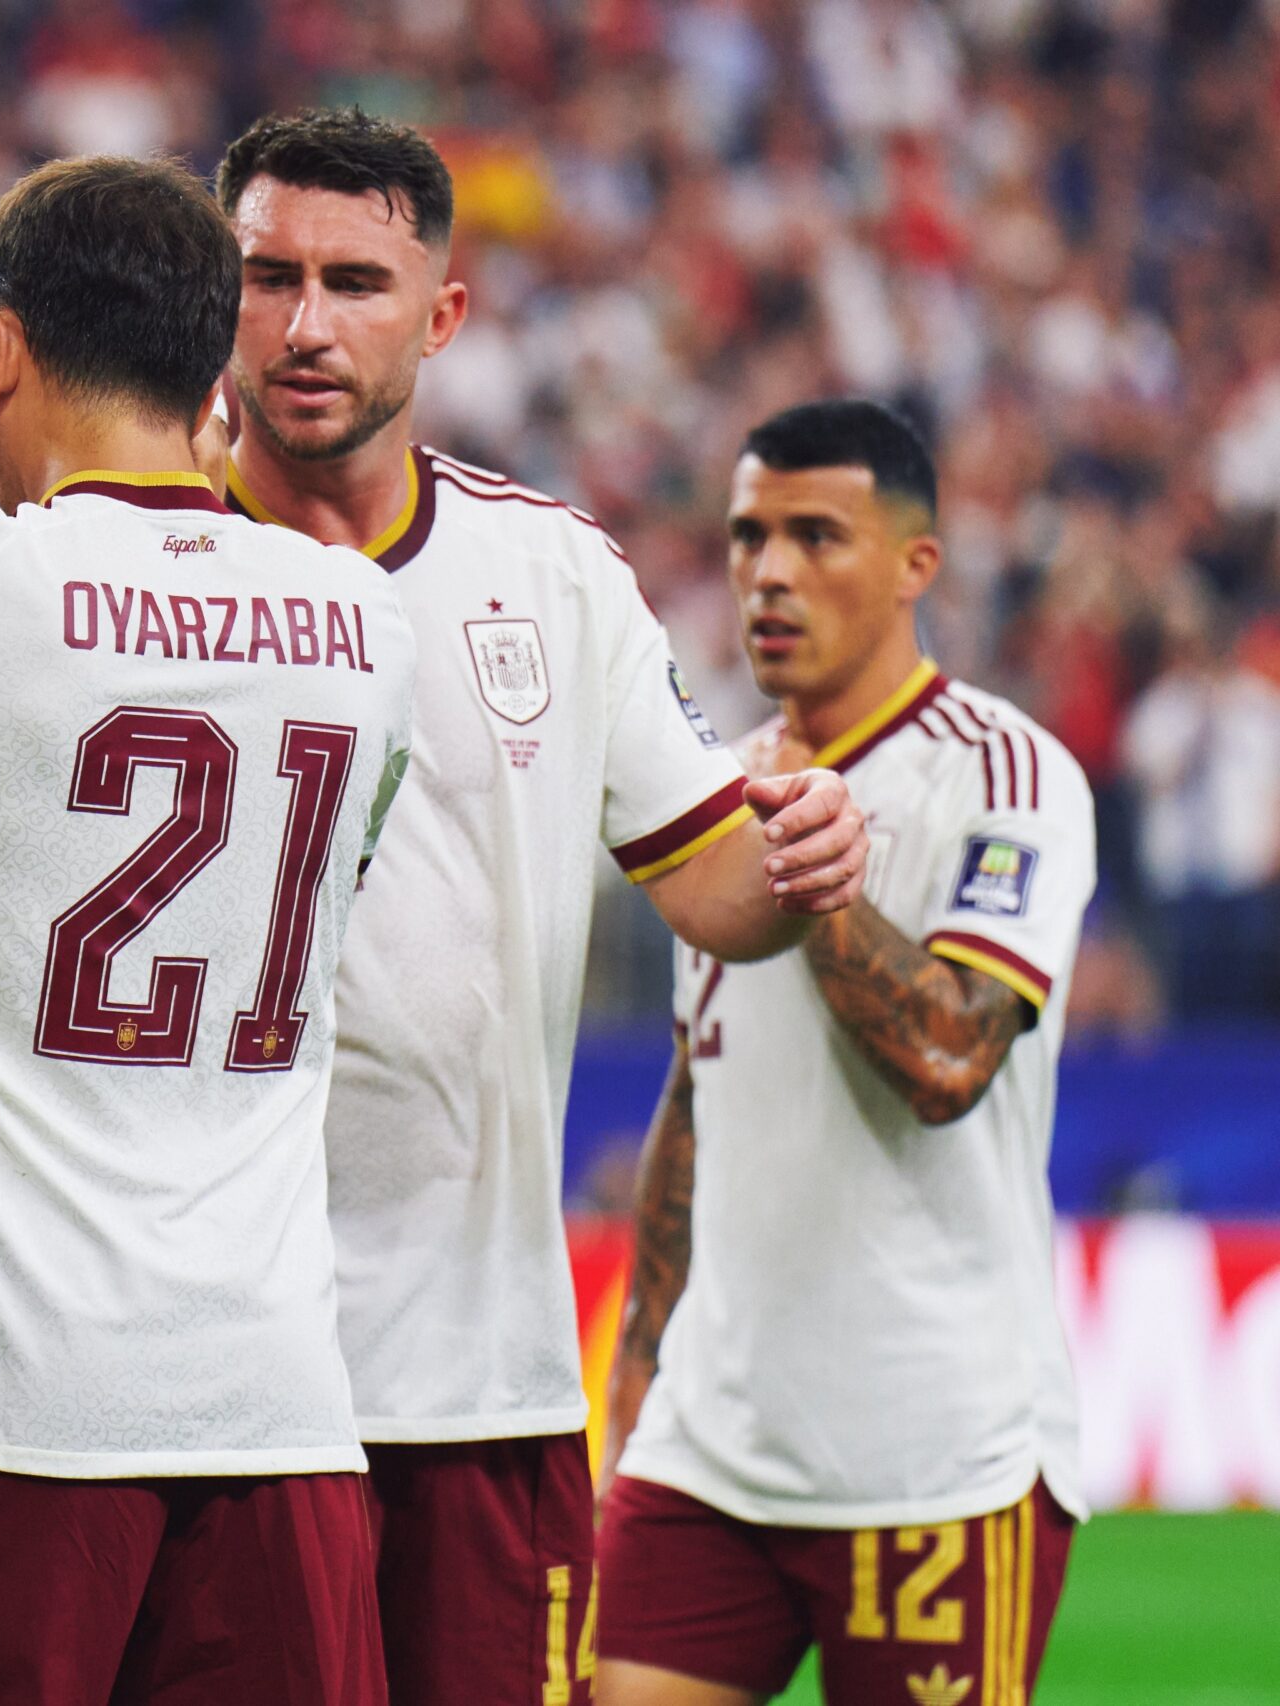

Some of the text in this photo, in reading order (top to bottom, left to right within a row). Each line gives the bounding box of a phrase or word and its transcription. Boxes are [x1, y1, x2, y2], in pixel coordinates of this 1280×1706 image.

[63, 581, 374, 674] OYARZABAL
[32, 705, 358, 1072] 21
[847, 1521, 967, 1645] 12
